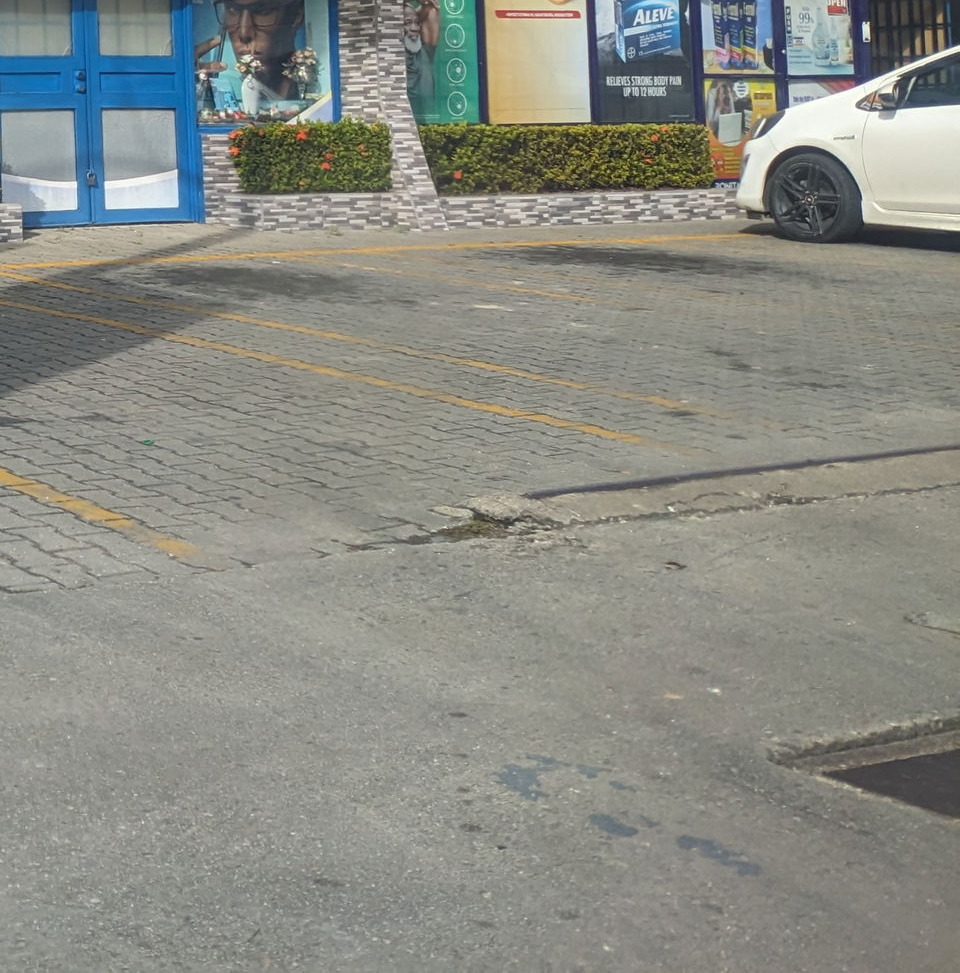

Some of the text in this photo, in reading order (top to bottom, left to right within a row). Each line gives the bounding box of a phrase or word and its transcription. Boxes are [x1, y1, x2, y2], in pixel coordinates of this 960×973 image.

[633, 6, 675, 27] ALEVE
[606, 76, 682, 86] RELIEVES STRONG BODY PAIN
[622, 87, 667, 97] UP TO 12 HOURS
